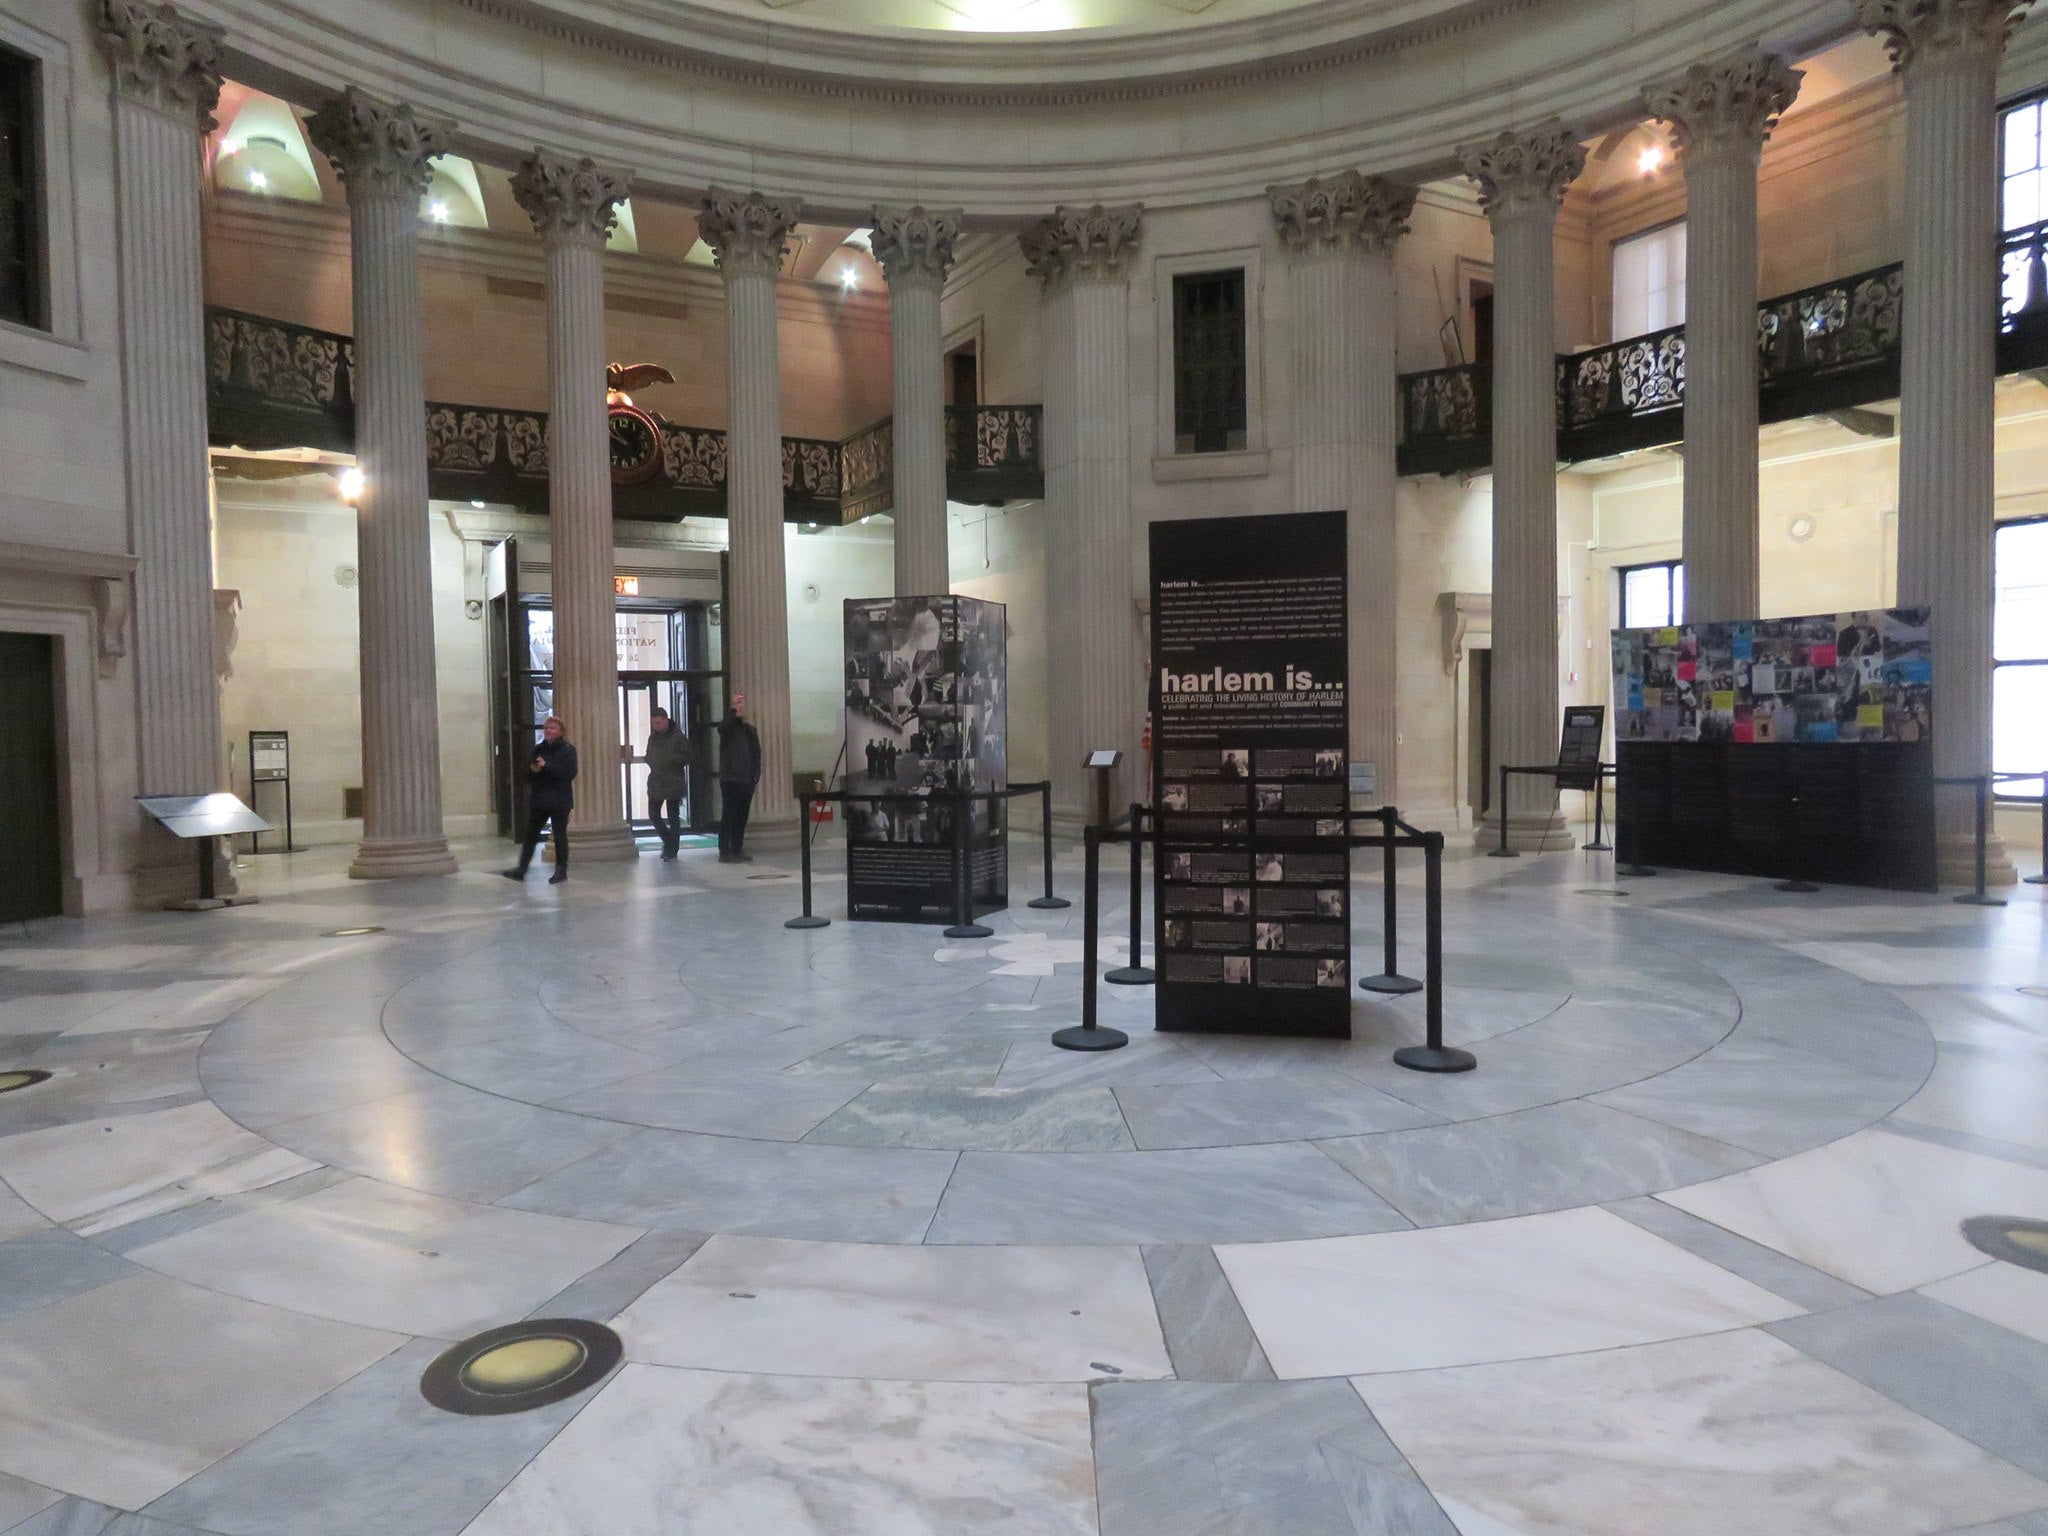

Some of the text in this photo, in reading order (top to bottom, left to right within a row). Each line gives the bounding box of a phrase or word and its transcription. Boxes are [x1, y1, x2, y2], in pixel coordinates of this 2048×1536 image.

[614, 578, 636, 594] EXIT
[1160, 580, 1189, 589] harlem
[1161, 664, 1344, 693] harlem is...
[1161, 691, 1344, 703] CELEBRATING THE LIVING HISTORY OF HARLEM
